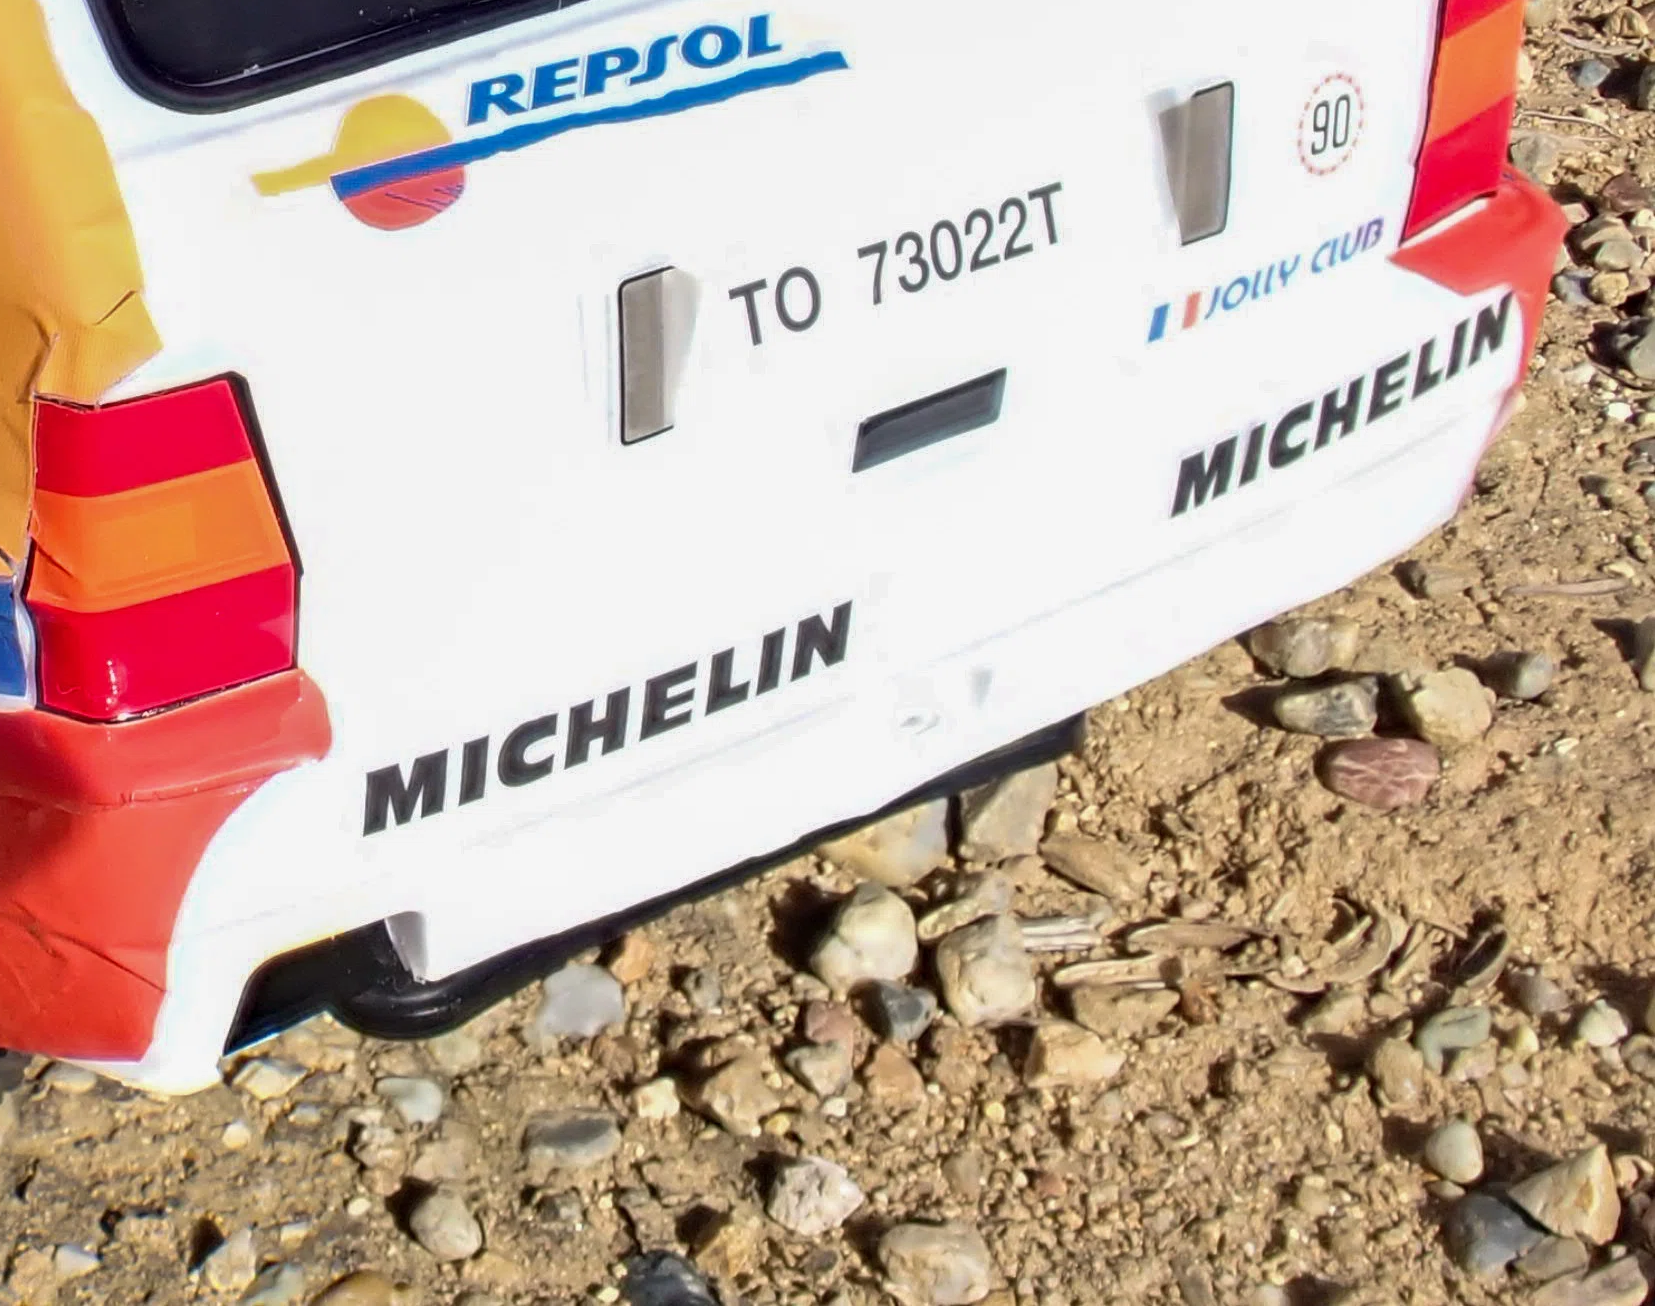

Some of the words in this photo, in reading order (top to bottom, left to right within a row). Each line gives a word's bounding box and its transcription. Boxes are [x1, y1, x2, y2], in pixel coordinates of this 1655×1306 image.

[466, 13, 783, 126] REPSOL
[1311, 93, 1351, 156] 90
[728, 266, 822, 346] TO
[856, 181, 1063, 306] 73022T
[1204, 254, 1301, 321] JOLLY
[1310, 216, 1385, 274] CLUB
[1170, 289, 1514, 519] MICHELIN
[362, 599, 854, 838] MICHELIN
